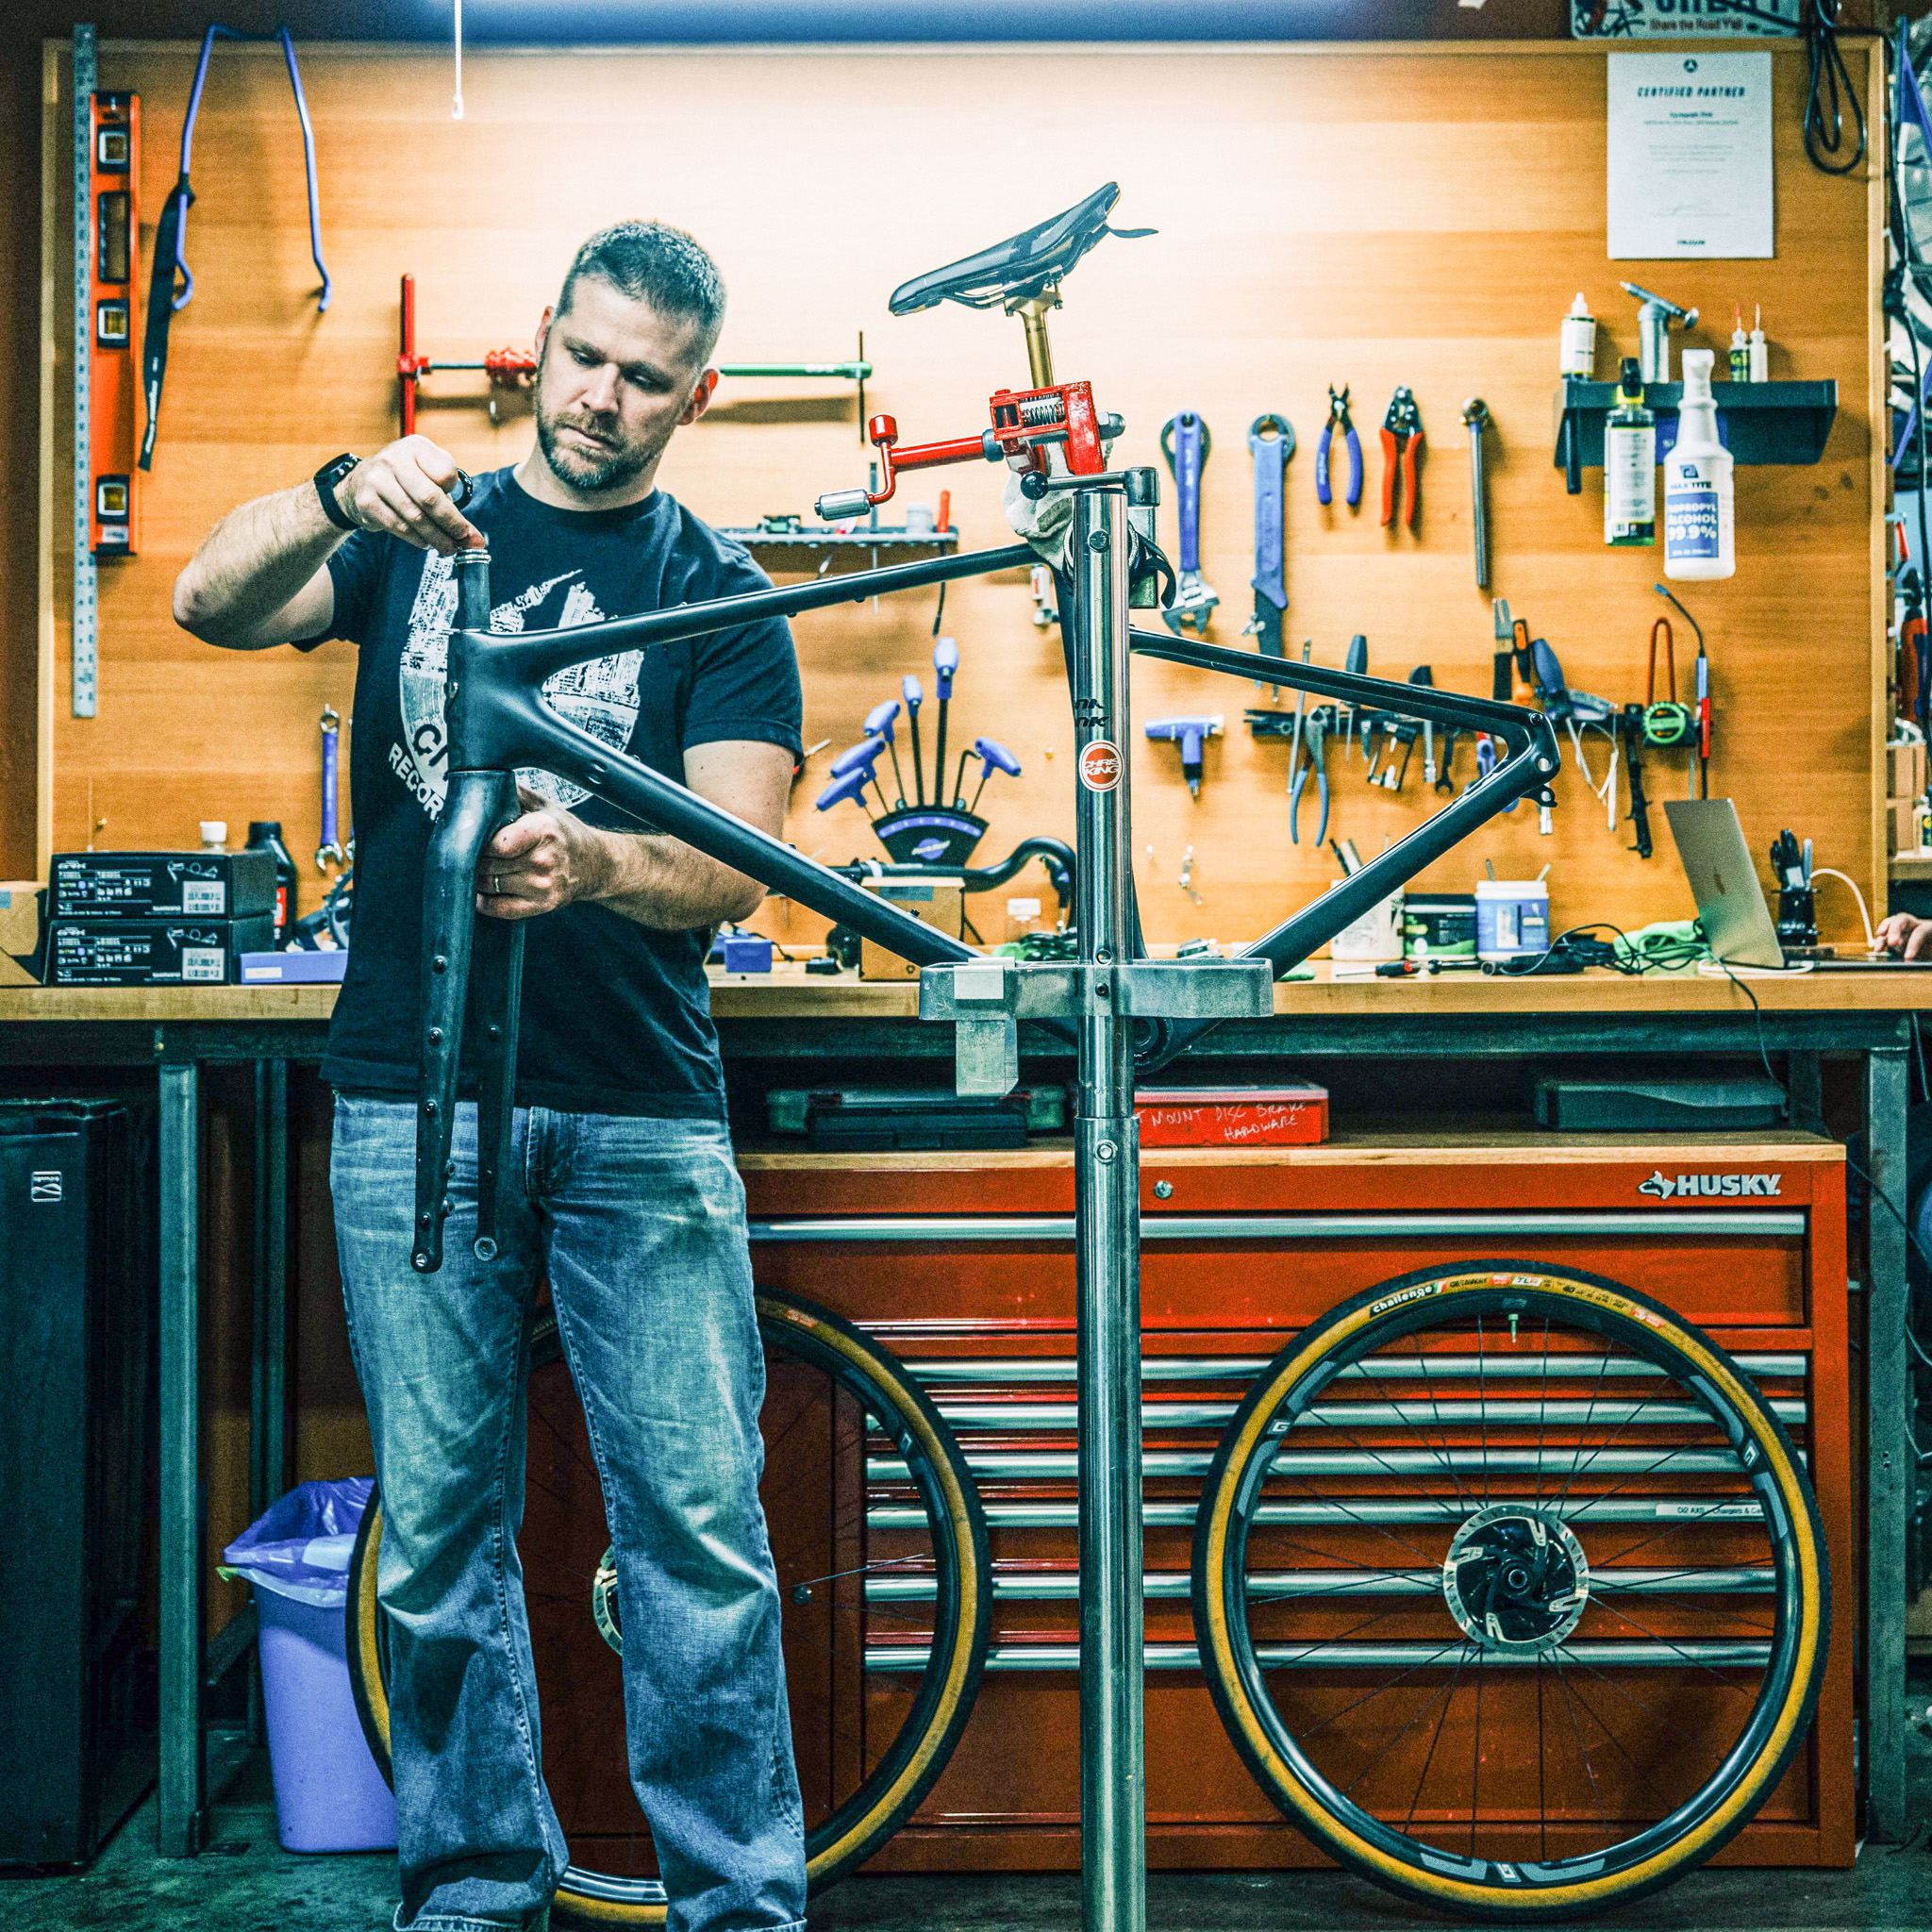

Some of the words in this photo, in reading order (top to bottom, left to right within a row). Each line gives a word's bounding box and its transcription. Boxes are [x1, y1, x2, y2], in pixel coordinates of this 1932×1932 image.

[1637, 86, 1693, 98] CERTIFIED
[1697, 86, 1746, 98] PARTNER
[1668, 513, 1718, 525] ALCOHOL
[1084, 758, 1120, 768] CHRIS
[1084, 766, 1120, 775] KING
[388, 742, 445, 821] RECOR
[1152, 1108, 1205, 1126] MOUNT
[1215, 1105, 1247, 1123] DISC
[1256, 1102, 1307, 1118] BRAKE
[1224, 1114, 1299, 1142] HARDWARE
[1676, 1174, 1782, 1196] HUSKY
